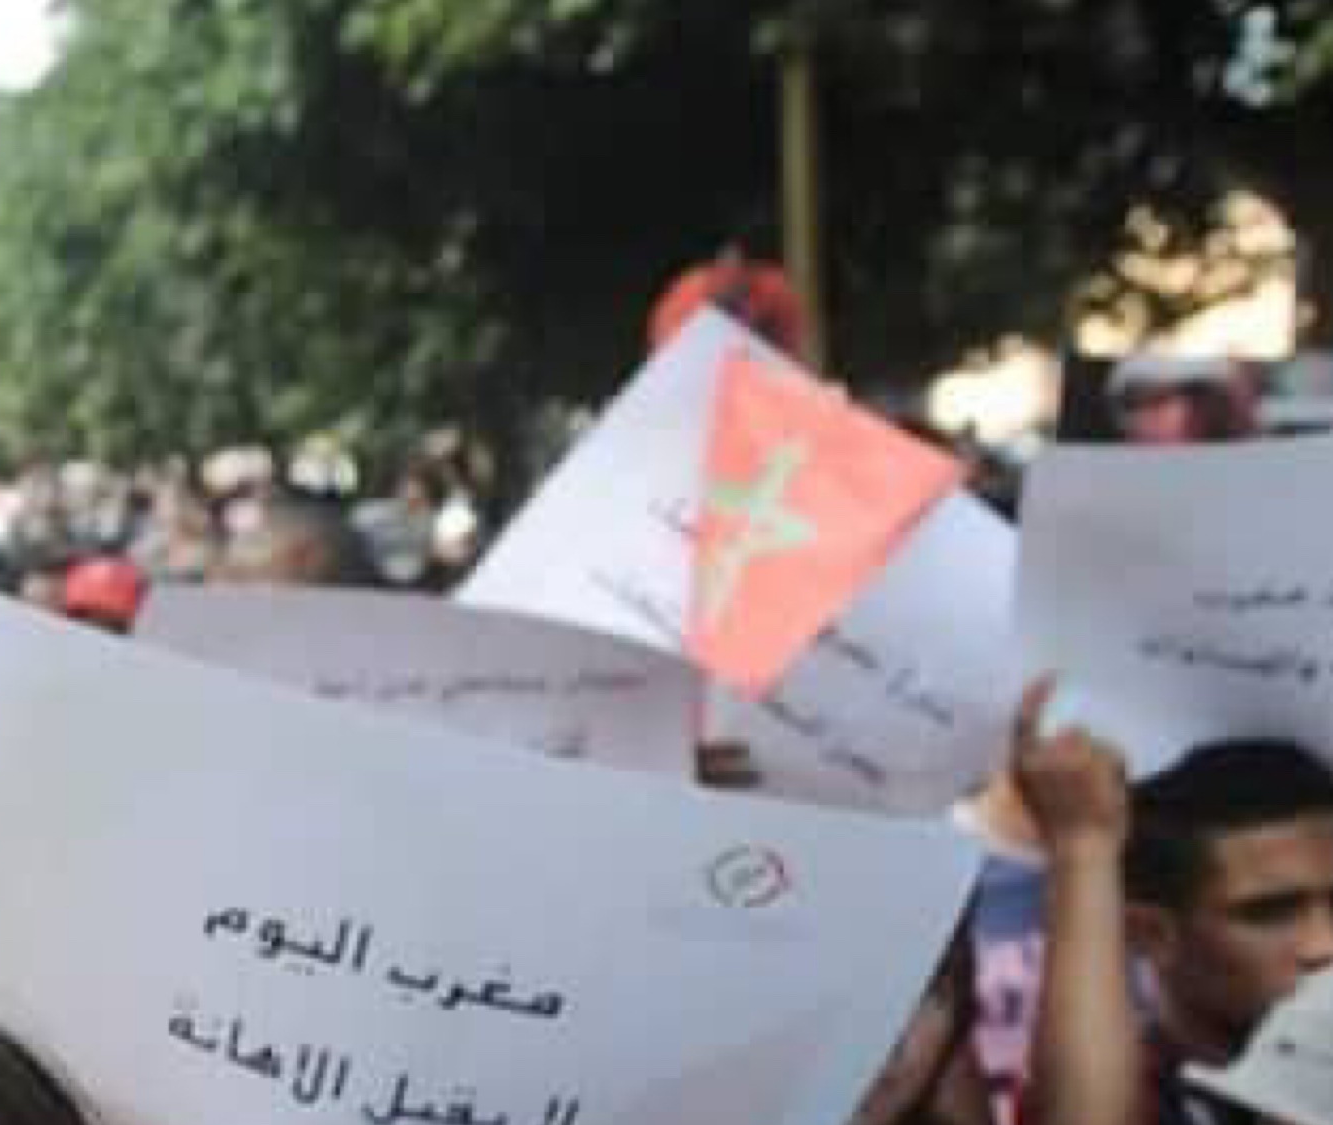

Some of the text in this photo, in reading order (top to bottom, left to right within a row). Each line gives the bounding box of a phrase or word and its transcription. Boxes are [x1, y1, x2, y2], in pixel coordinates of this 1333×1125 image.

[203, 907, 564, 1018] مغرب اليوم
[168, 996, 349, 1104] الاهانة
